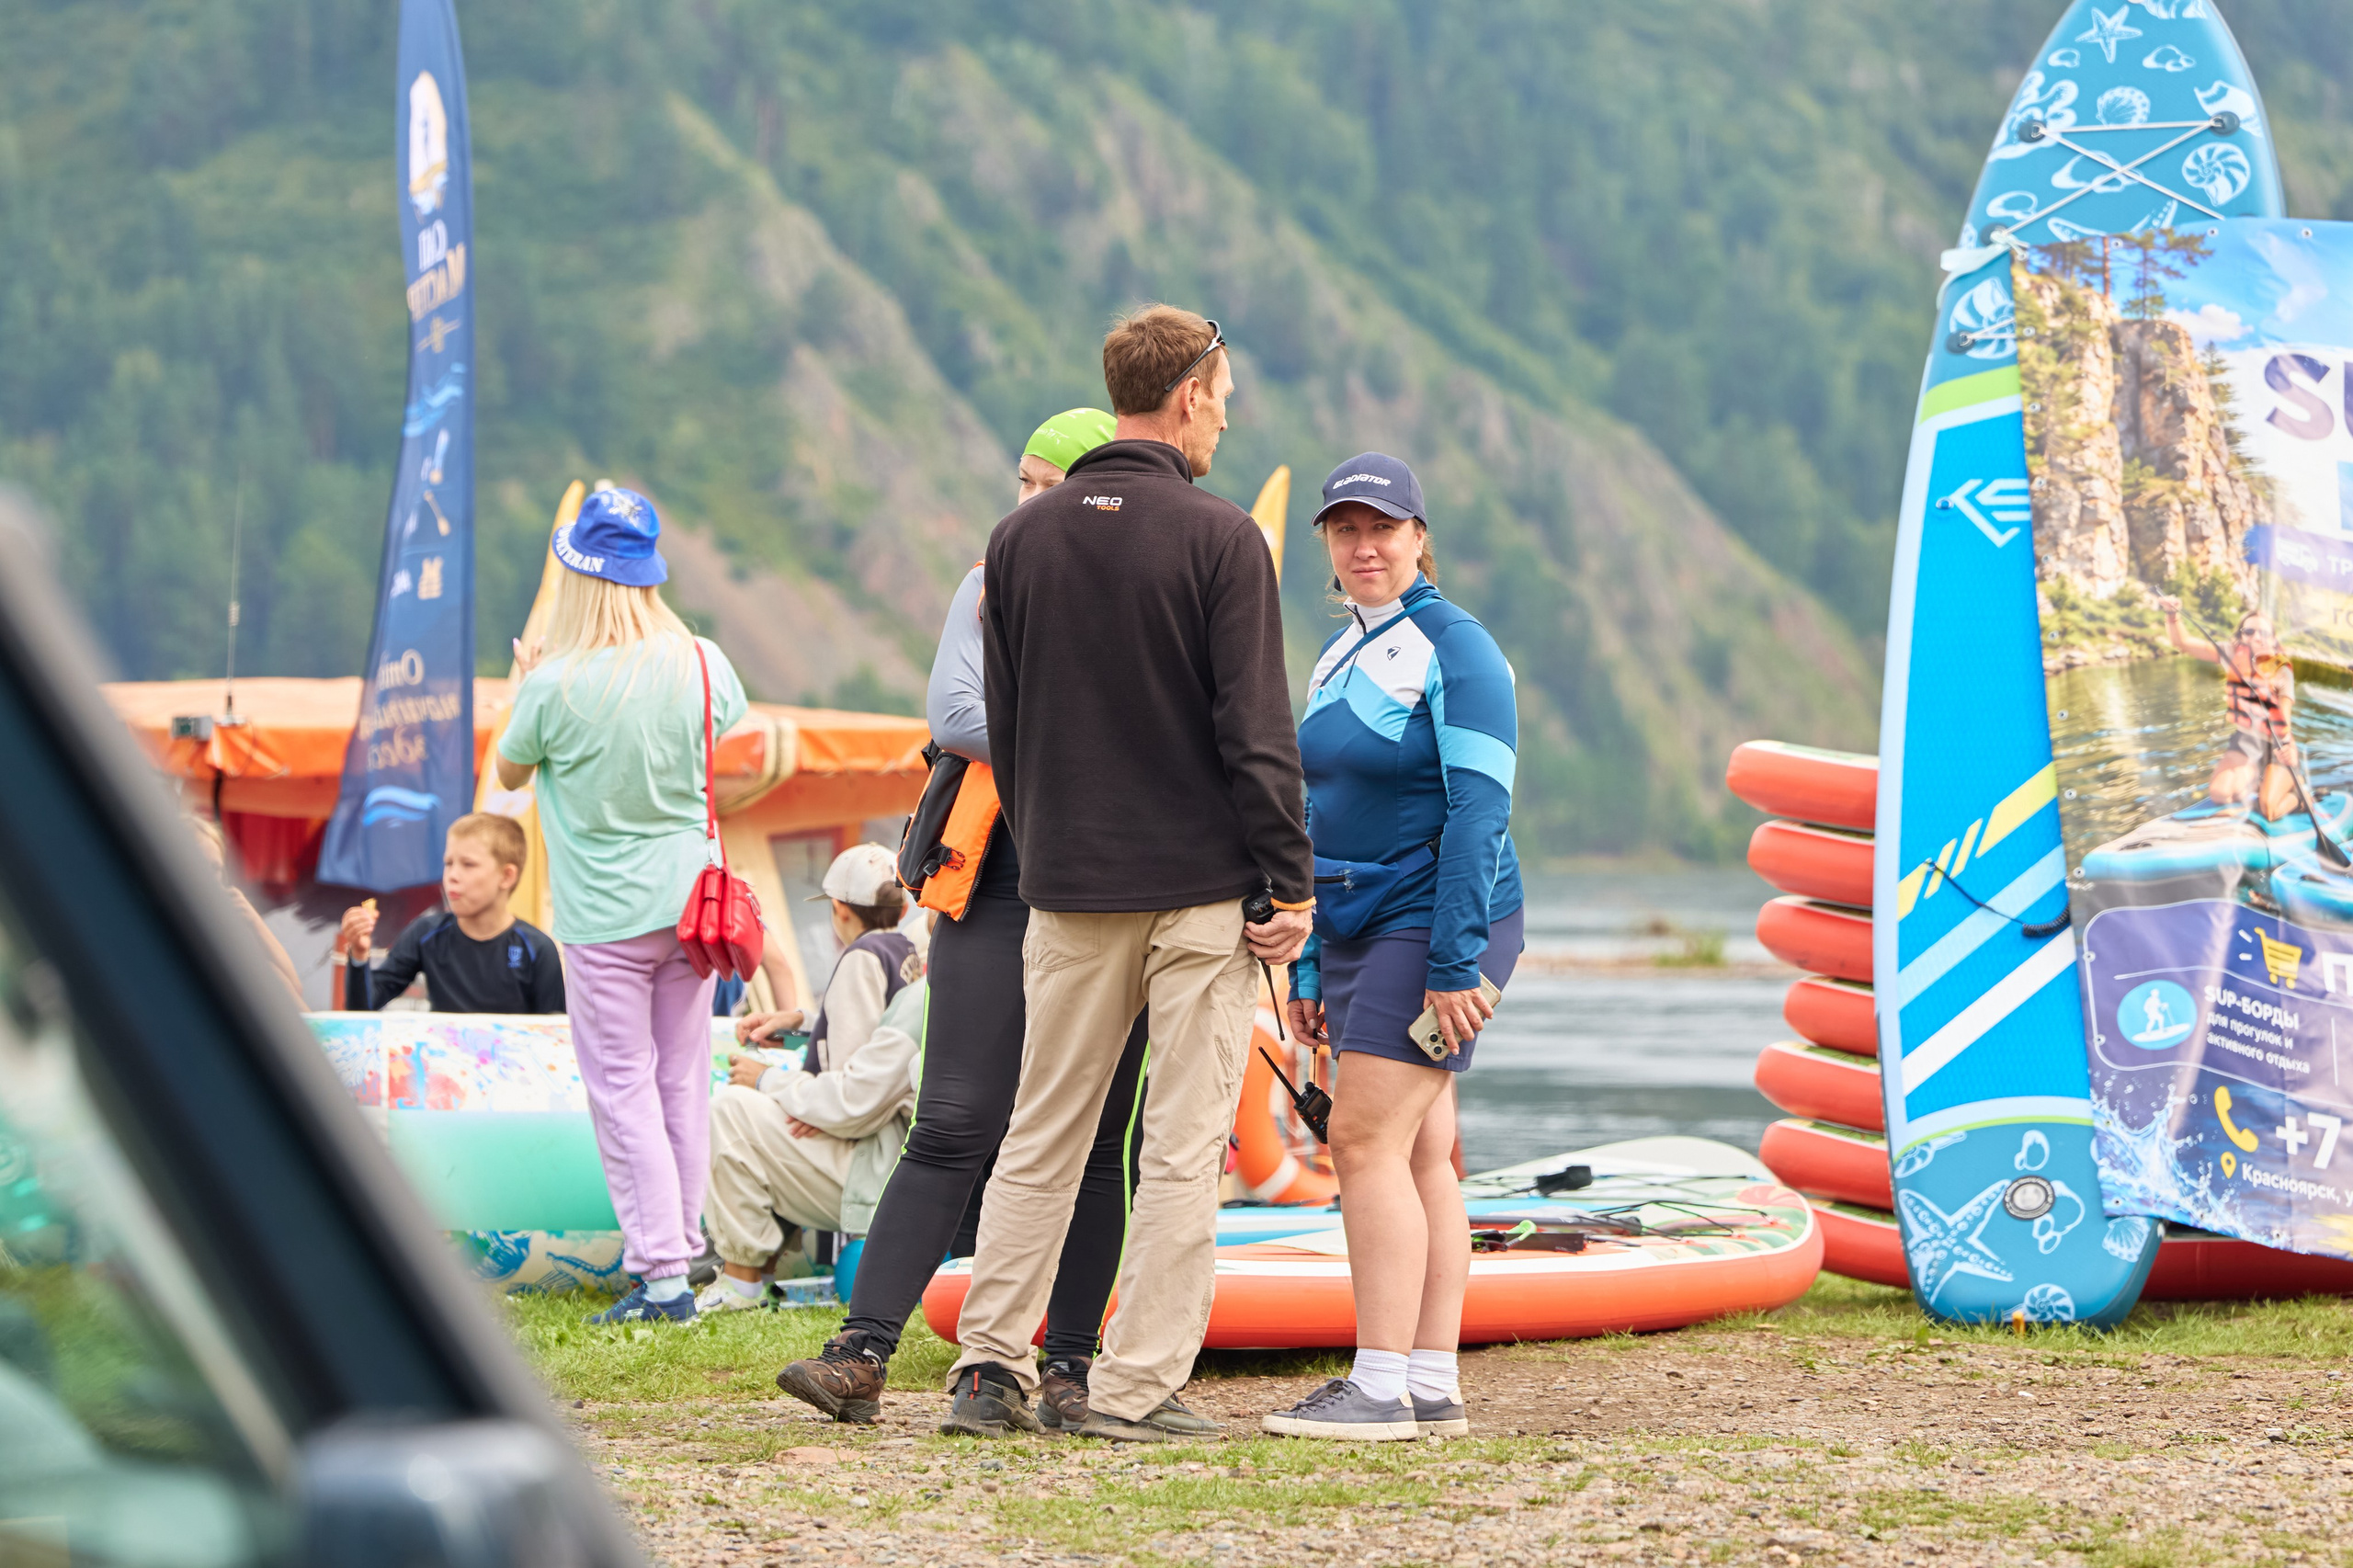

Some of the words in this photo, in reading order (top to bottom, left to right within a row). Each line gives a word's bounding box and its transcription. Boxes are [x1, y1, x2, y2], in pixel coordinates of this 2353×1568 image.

[1083, 495, 1123, 506] NEO
[2204, 985, 2299, 1030] SUP-БОРДЫ
[2206, 1012, 2228, 1028] для
[2230, 1018, 2282, 1047] прогулок
[2284, 1036, 2294, 1050] и
[2207, 1032, 2264, 1062] активного
[2266, 1051, 2311, 1074] отдыха
[2276, 1111, 2341, 1170] +7
[2242, 1163, 2340, 1204] Красноярск,
